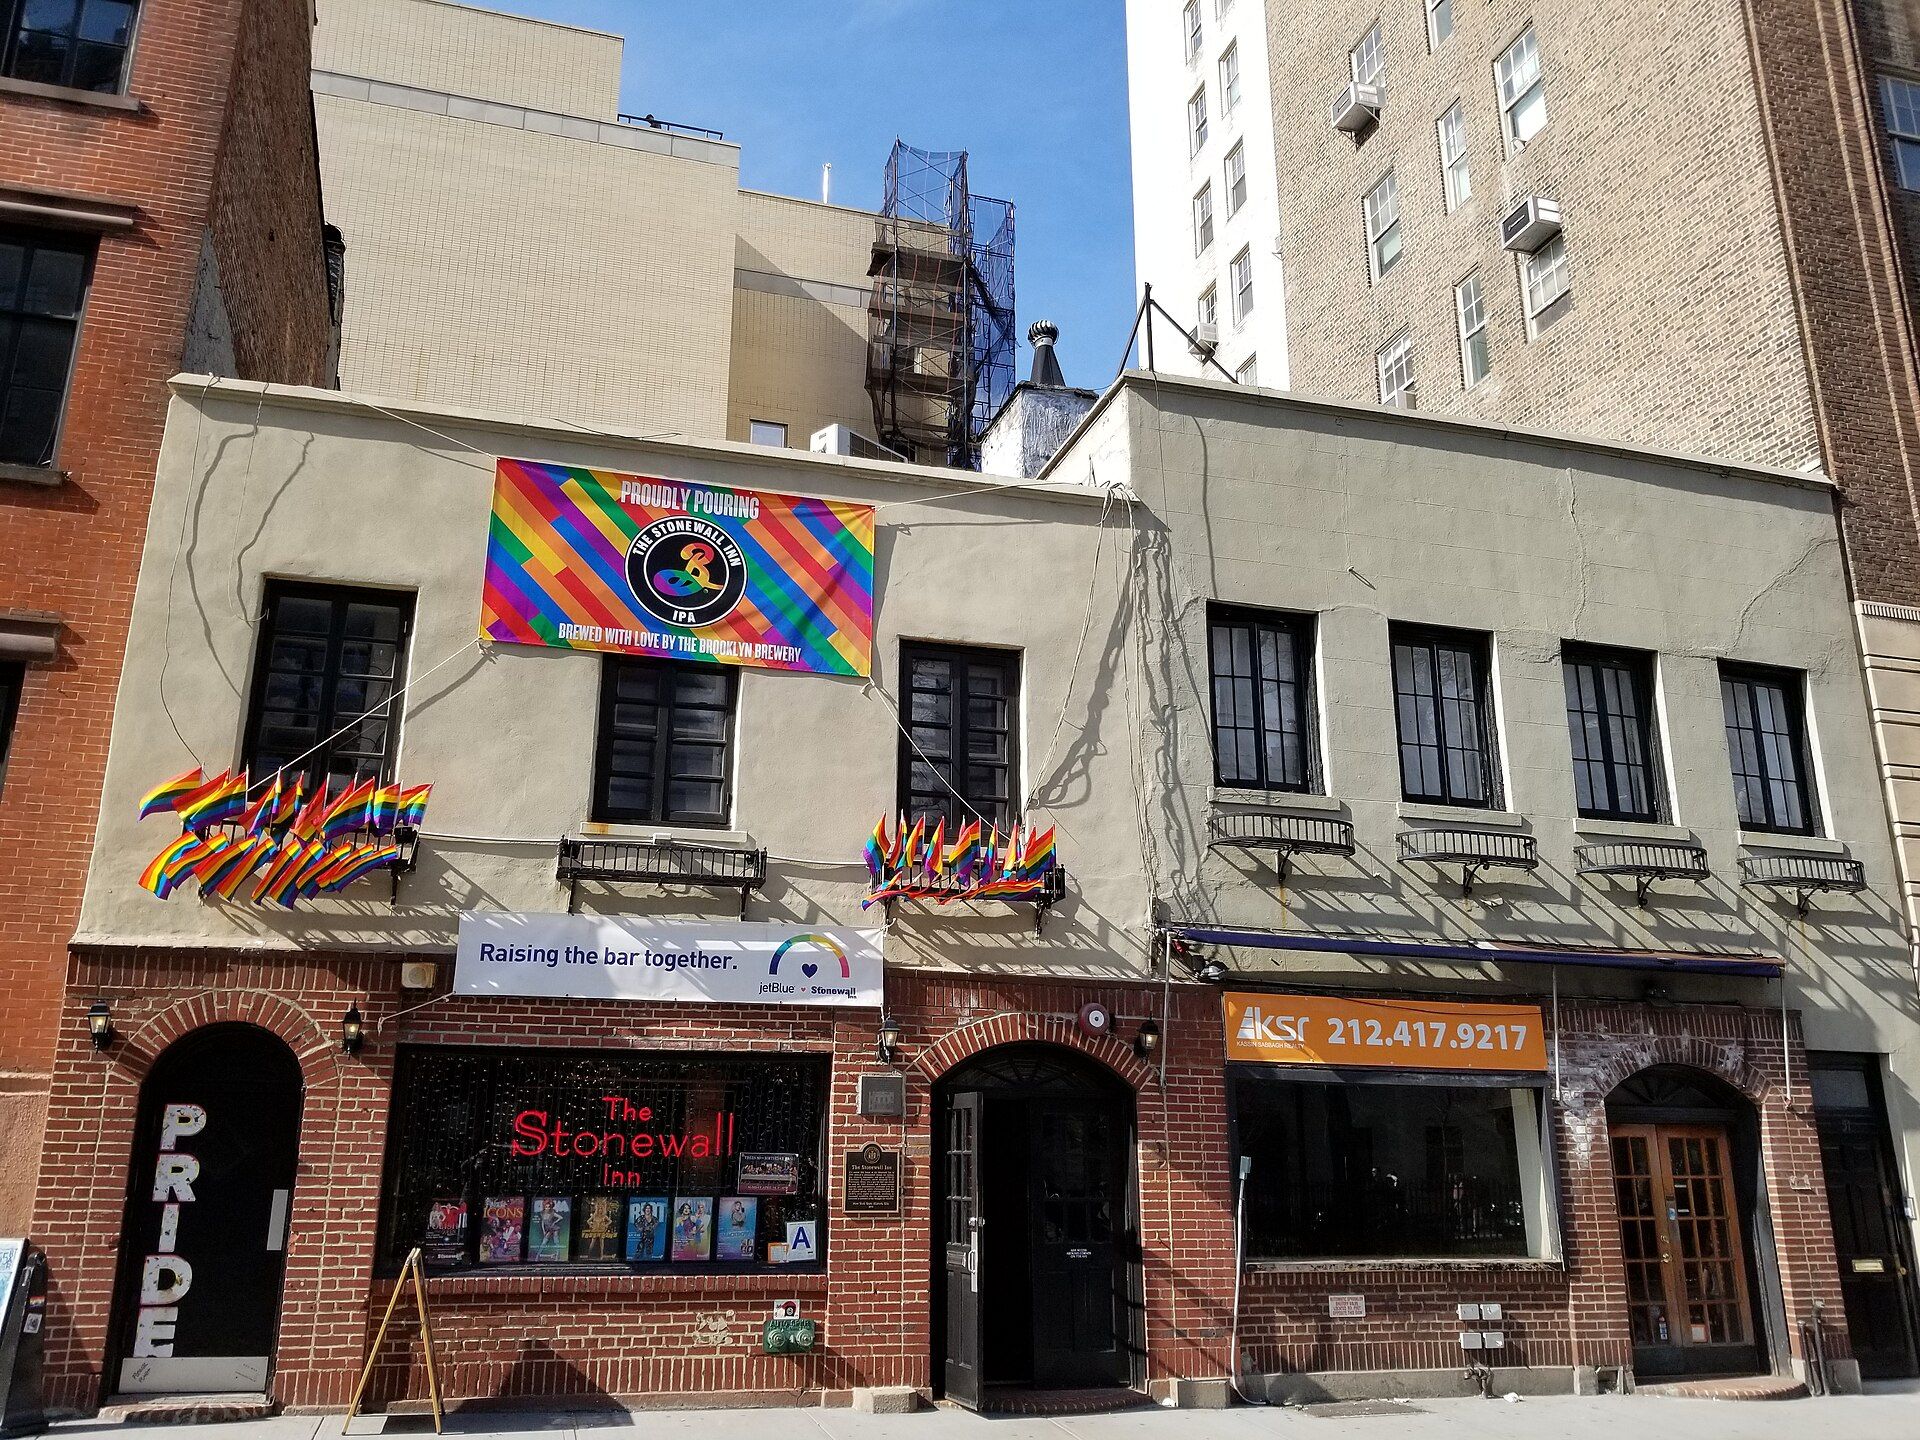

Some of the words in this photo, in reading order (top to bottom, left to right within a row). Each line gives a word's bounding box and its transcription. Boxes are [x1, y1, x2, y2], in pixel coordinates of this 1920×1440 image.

[621, 481, 691, 511] PROUDLY
[694, 490, 759, 520] POURING
[632, 534, 653, 556] THE
[651, 520, 726, 546] STONEWALL
[723, 542, 742, 567] INN
[672, 610, 696, 623] IPA
[558, 622, 602, 643] BREWED
[604, 627, 632, 646] WITH
[634, 631, 660, 648] LOVE
[662, 634, 676, 650] BY
[678, 636, 697, 653] THE
[699, 638, 752, 658] BROOKLYN
[755, 643, 801, 663] BREWERY
[480, 943, 559, 966] Raising
[565, 947, 598, 966] the
[604, 947, 640, 966] bar
[644, 949, 738, 972] together.
[759, 982, 795, 995] jetBlue
[811, 986, 856, 996] Stonewall
[1326, 1017, 1527, 1051] 212.417.9217
[602, 1096, 653, 1122] The
[511, 1110, 735, 1158] Stonewall
[603, 1165, 641, 1189] Inn
[483, 1207, 523, 1218] ICONS
[133, 1104, 207, 1358] PRIDE
[791, 1226, 811, 1250] A
